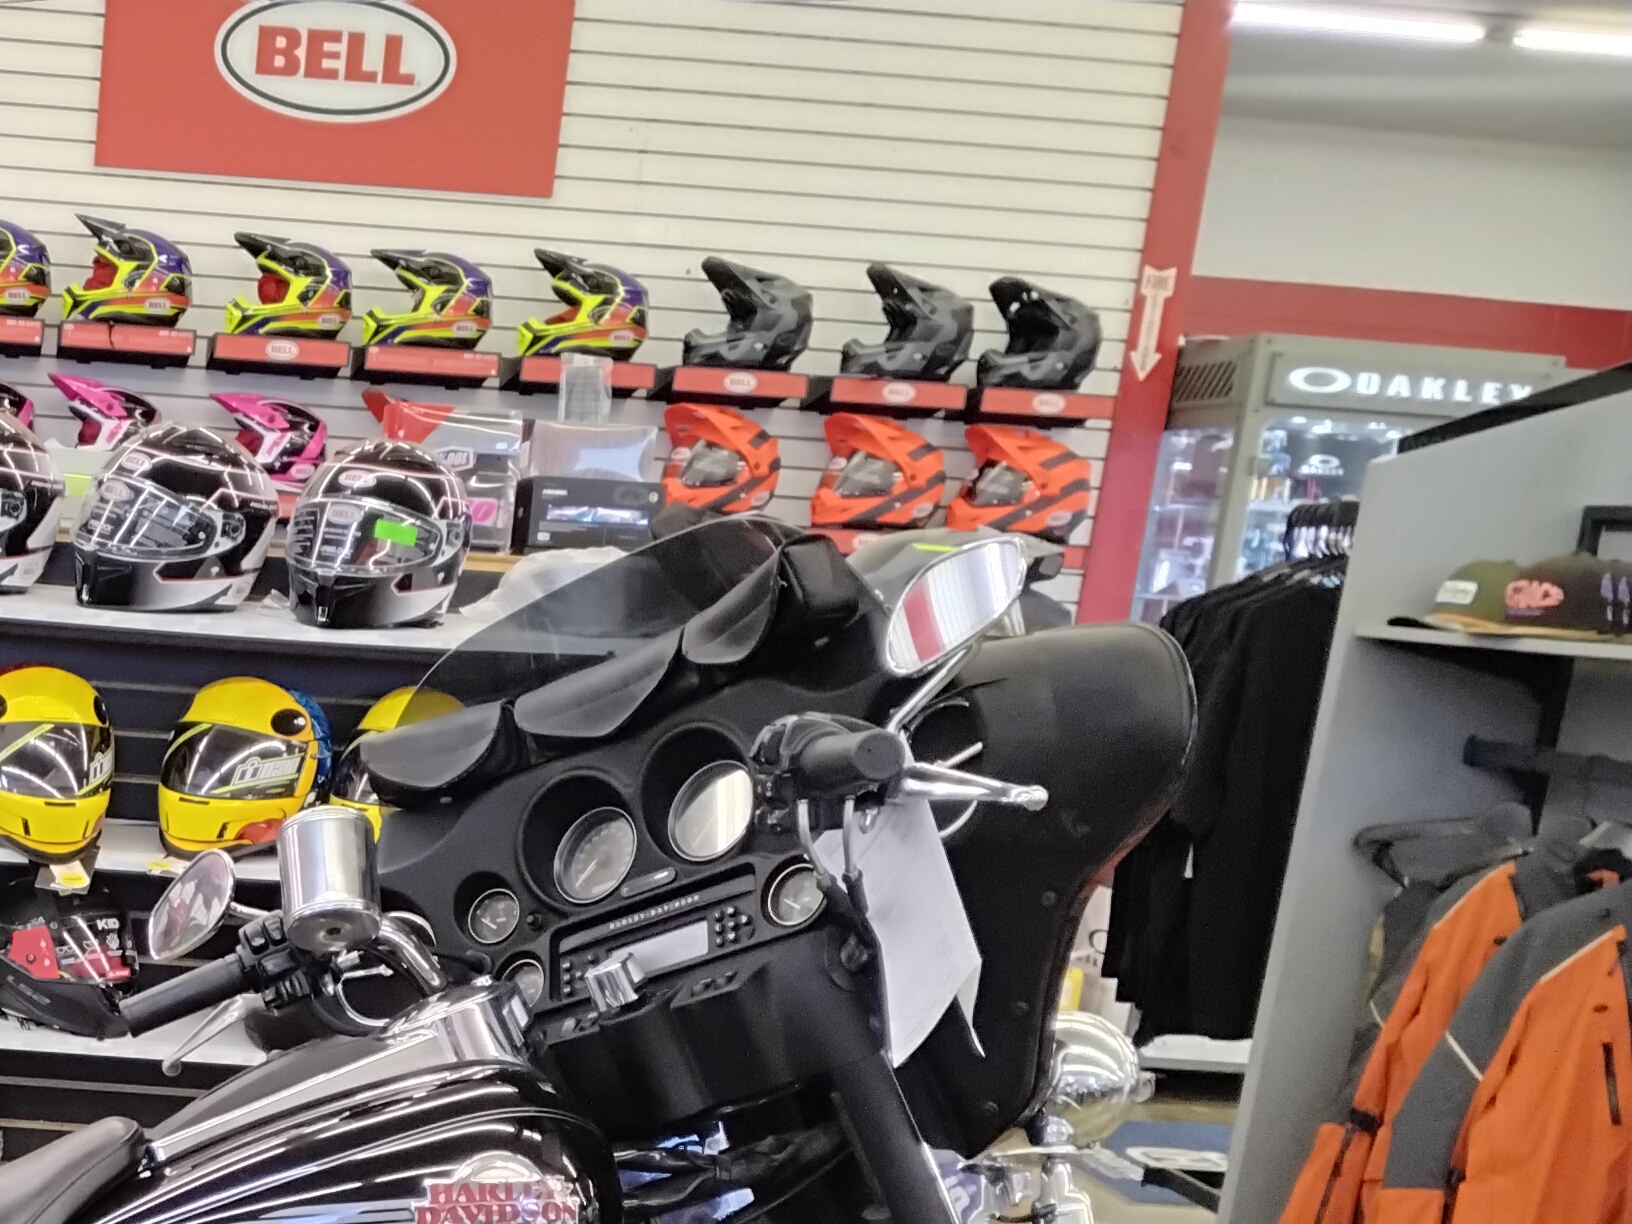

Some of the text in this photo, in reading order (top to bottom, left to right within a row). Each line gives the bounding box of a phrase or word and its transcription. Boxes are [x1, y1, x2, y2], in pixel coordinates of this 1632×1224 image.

[255, 25, 416, 86] BELL
[7, 291, 29, 299] BELL
[148, 301, 168, 310] BELL
[321, 316, 340, 325] BELL
[455, 323, 476, 332] BELL
[270, 345, 294, 355] BELL
[729, 377, 752, 387] BELL
[125, 456, 146, 467] BELL
[96, 918, 120, 930] KID
